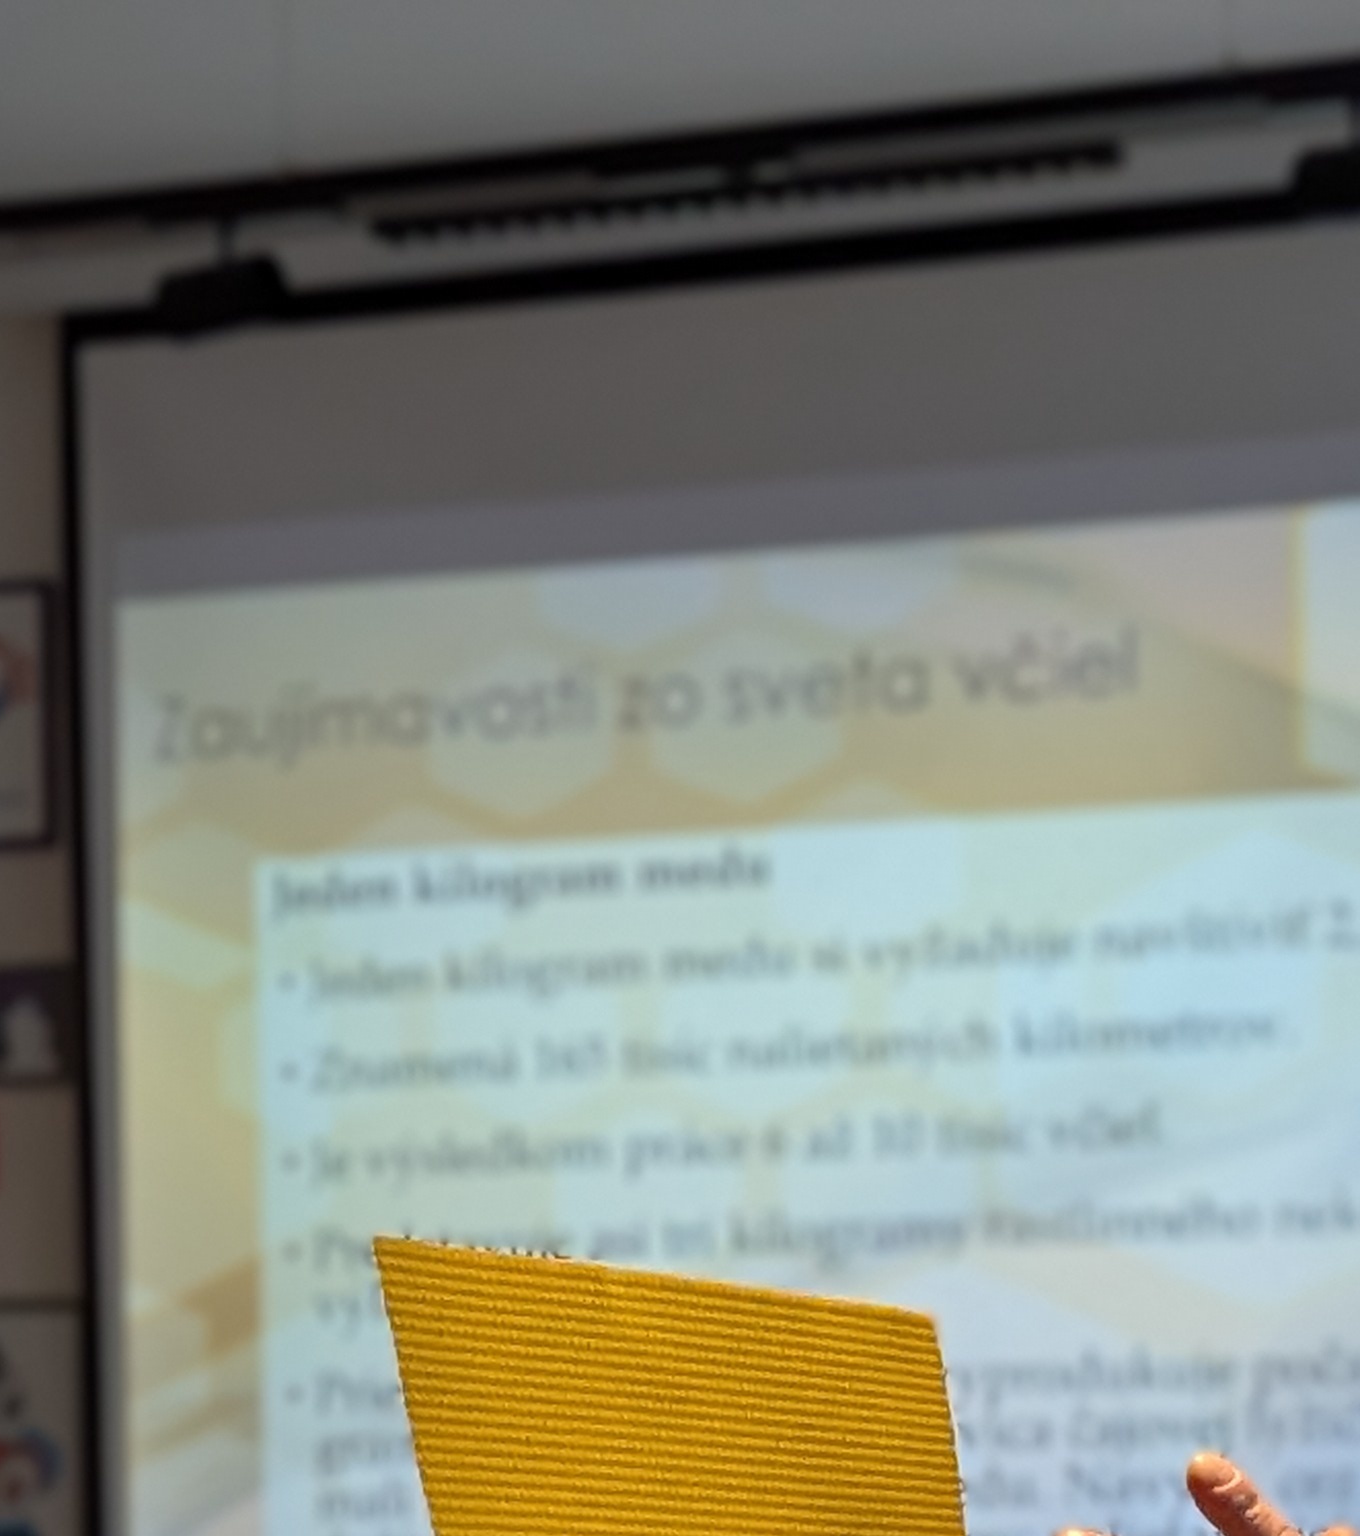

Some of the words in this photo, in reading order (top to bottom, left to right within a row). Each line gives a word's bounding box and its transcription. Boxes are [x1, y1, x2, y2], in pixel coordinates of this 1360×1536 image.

[153, 666, 598, 770] Zaujímavosti
[616, 676, 703, 735] zo
[721, 652, 932, 724] sveta
[952, 626, 1142, 706] včiel
[272, 870, 397, 918] Jeden
[412, 857, 620, 912] kilogram
[636, 846, 773, 890] medu
[310, 955, 431, 1004] Jeden
[445, 944, 647, 1000] kilogram
[662, 933, 796, 979] medu
[311, 1037, 517, 1090] Znamená
